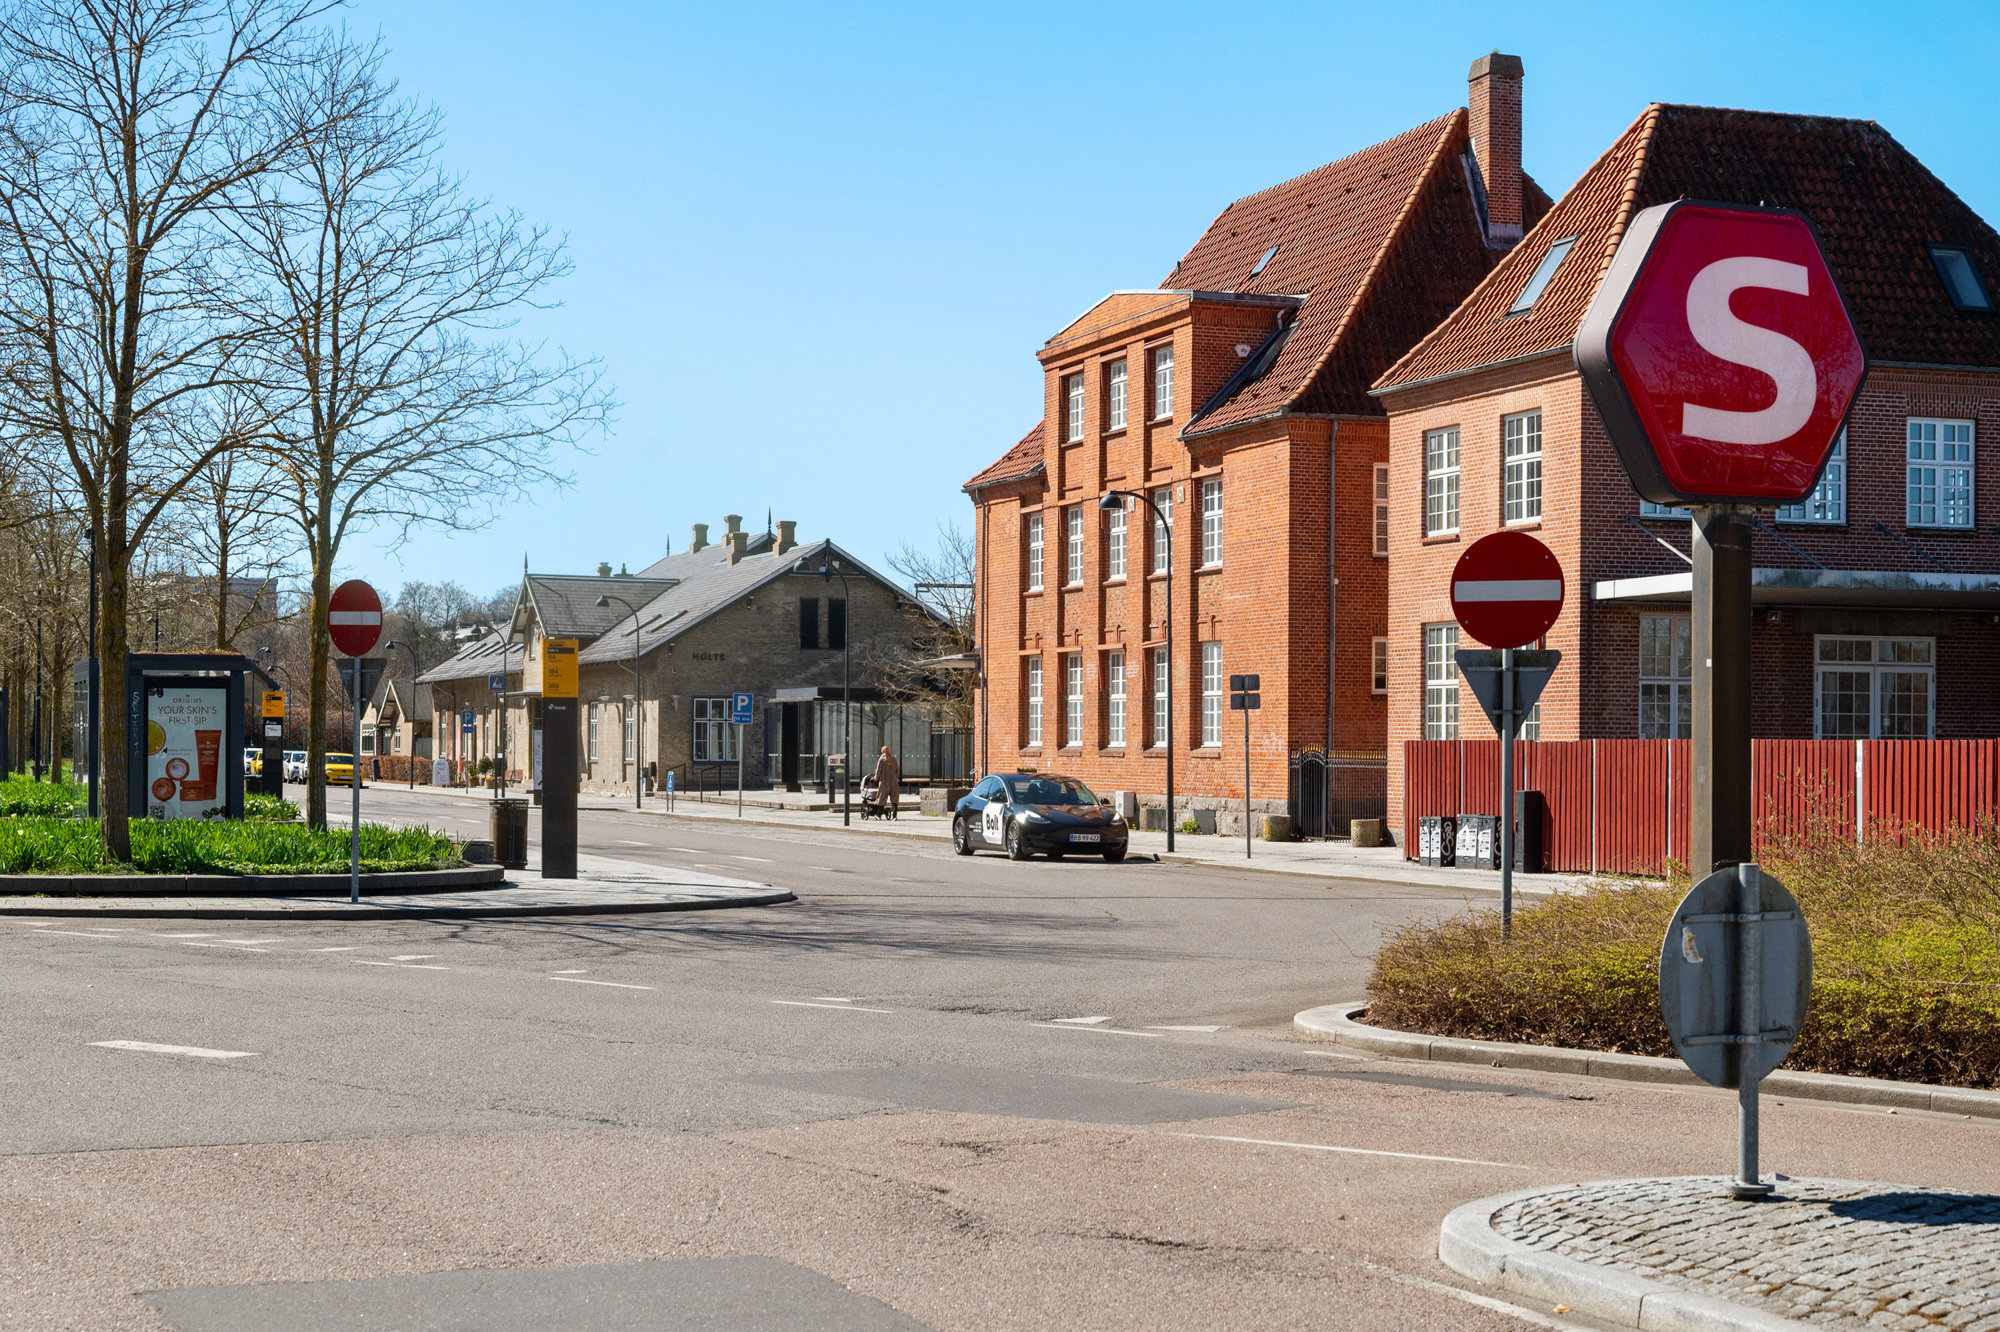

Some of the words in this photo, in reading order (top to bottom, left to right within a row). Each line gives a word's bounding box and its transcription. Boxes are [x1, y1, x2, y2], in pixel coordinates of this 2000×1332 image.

[1682, 256, 1817, 445] S
[692, 652, 726, 661] HOLTE
[737, 696, 749, 711] P
[158, 706, 184, 714] YOUR
[186, 706, 217, 714] SKIN'S
[168, 716, 191, 724] FIRST
[194, 716, 207, 725] SIP
[464, 712, 472, 722] P
[986, 814, 999, 830] Bolt
